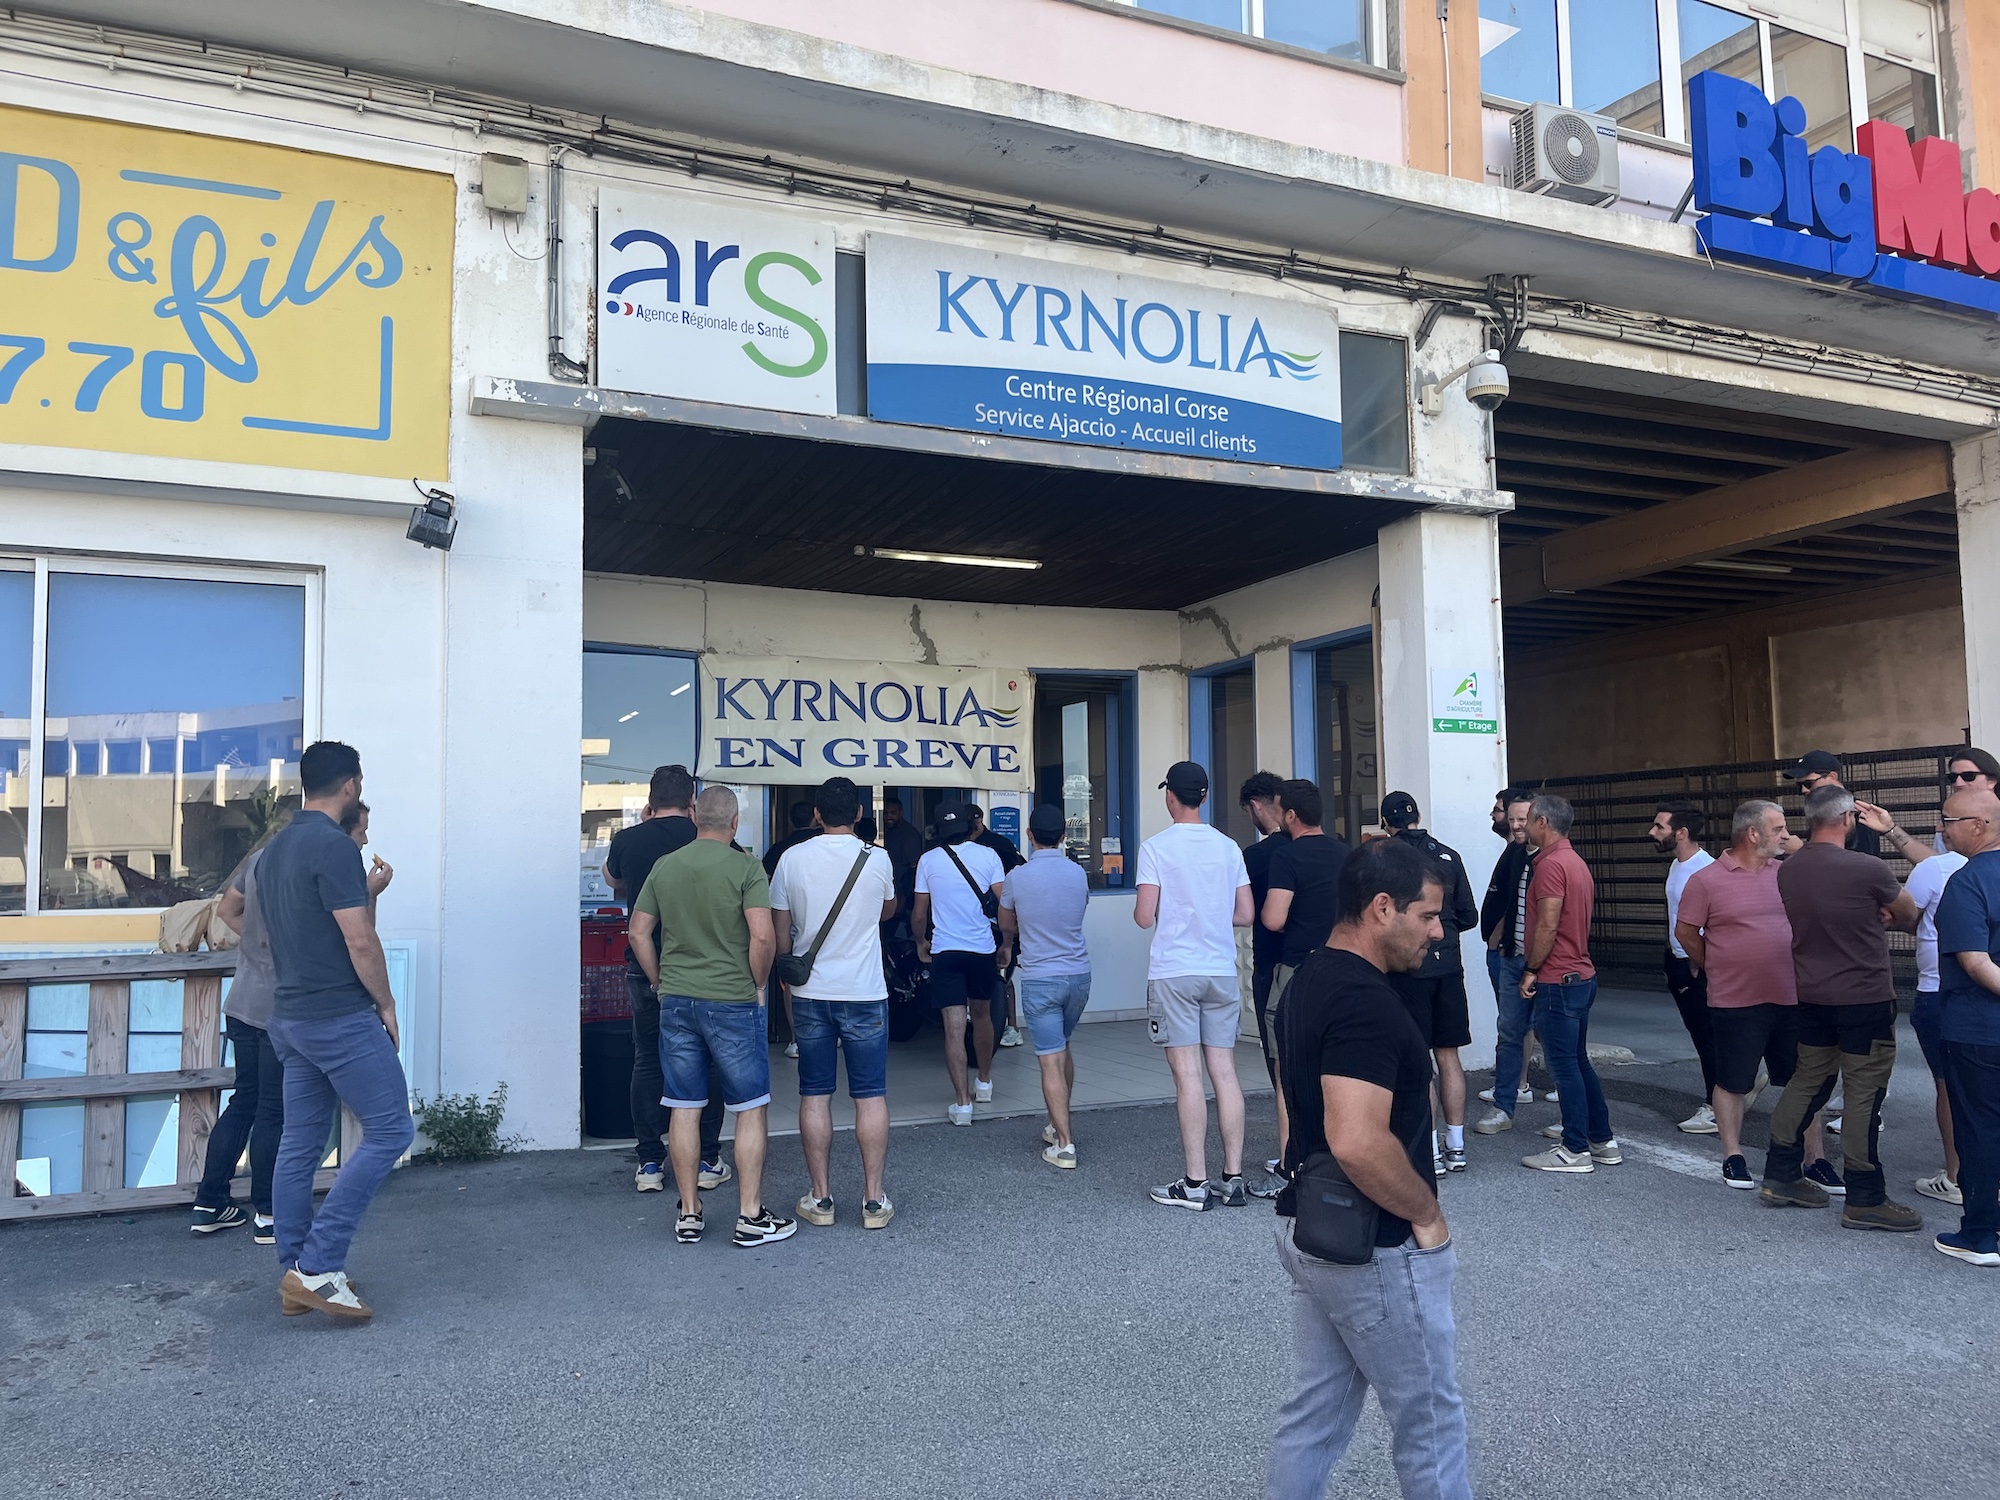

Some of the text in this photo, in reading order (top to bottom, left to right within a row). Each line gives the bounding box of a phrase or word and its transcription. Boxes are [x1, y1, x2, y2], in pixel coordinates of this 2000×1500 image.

[1597, 126, 1616, 137] HITACHI
[107, 212, 157, 284] &
[154, 200, 403, 383] fils
[607, 229, 828, 378] ars
[636, 304, 790, 339] Agence Régionale de Santé
[935, 270, 1284, 379] KYRNOLIA
[1005, 375, 1229, 422] Centre Régional Corse
[974, 403, 1044, 429] Service
[1049, 412, 1116, 438] Ajaccio
[1131, 422, 1196, 447] Accueil
[1200, 429, 1257, 453] clients
[714, 677, 991, 728] KYRNOLIA
[714, 738, 1020, 774] EN GREVE
